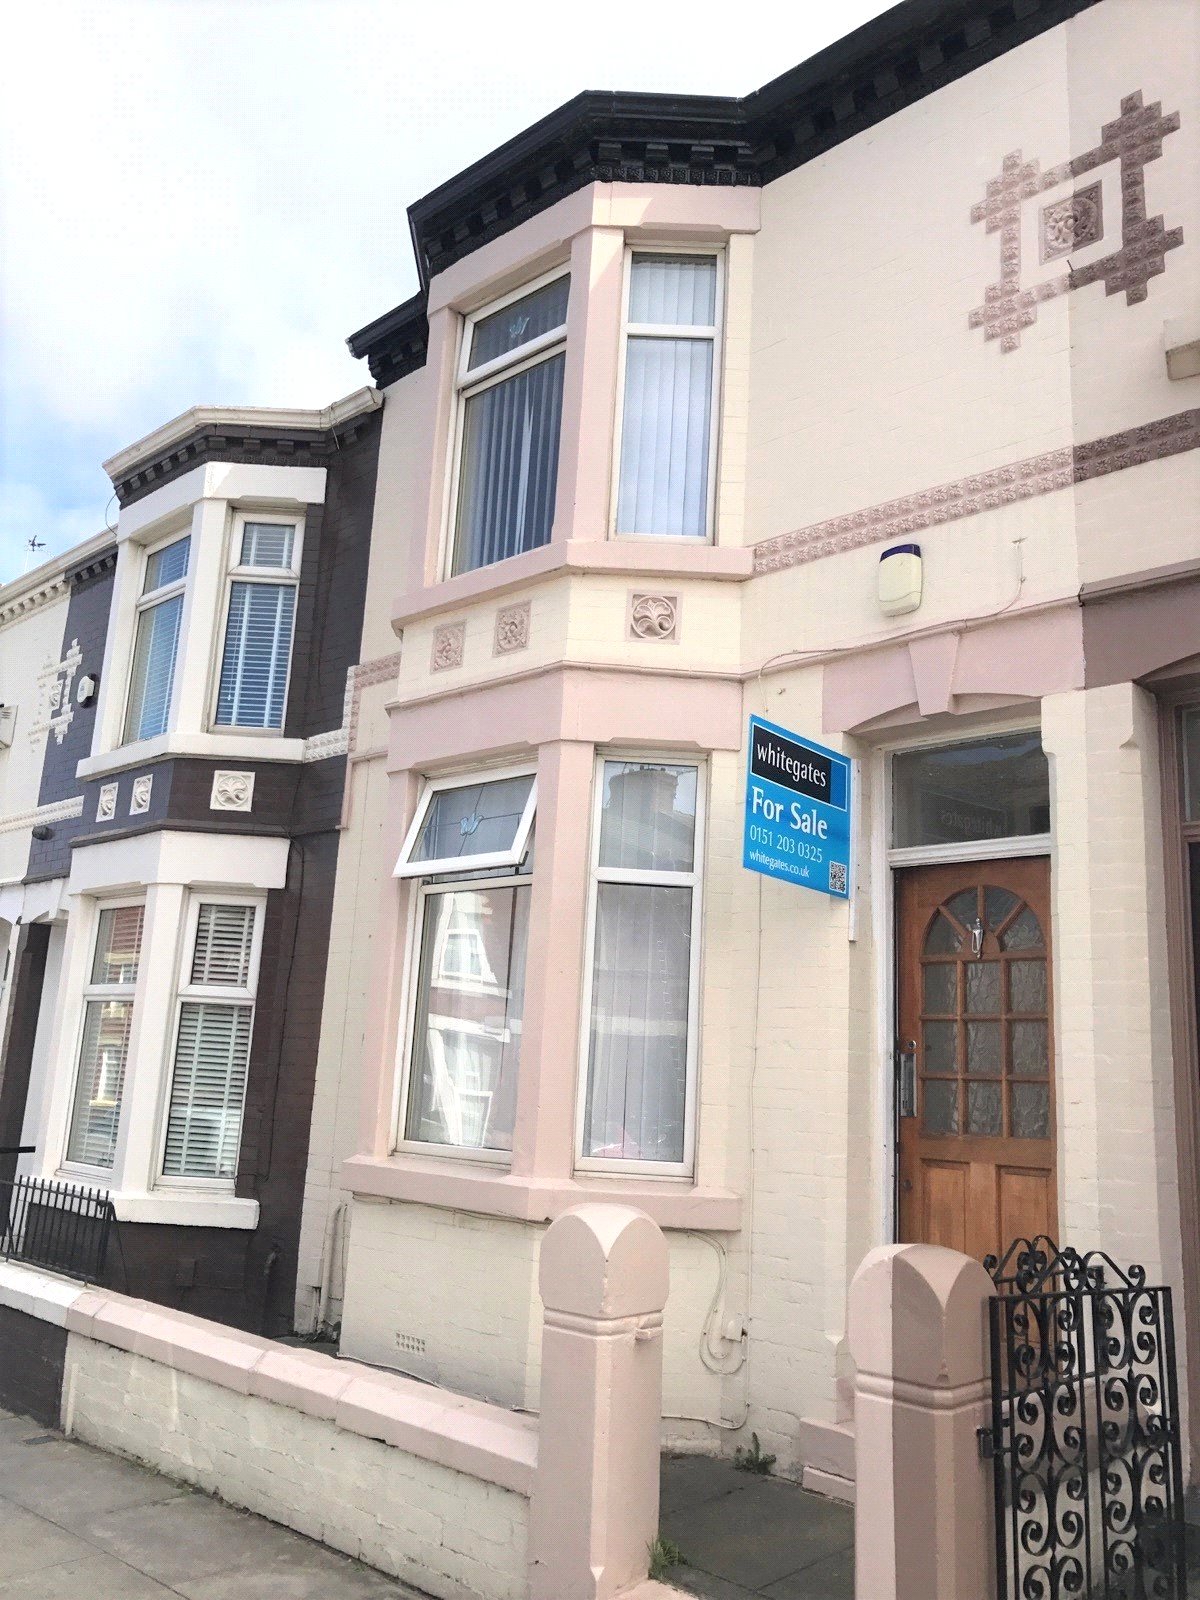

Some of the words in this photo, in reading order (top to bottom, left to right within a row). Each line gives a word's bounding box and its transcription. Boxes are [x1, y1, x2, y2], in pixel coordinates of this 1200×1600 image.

[757, 743, 826, 787] whitegates
[752, 785, 784, 822] For
[790, 802, 828, 840] Sale
[749, 849, 810, 878] whitegates.co.uk
[750, 824, 773, 847] 0151
[777, 834, 795, 854] 203
[797, 841, 823, 863] 0325
